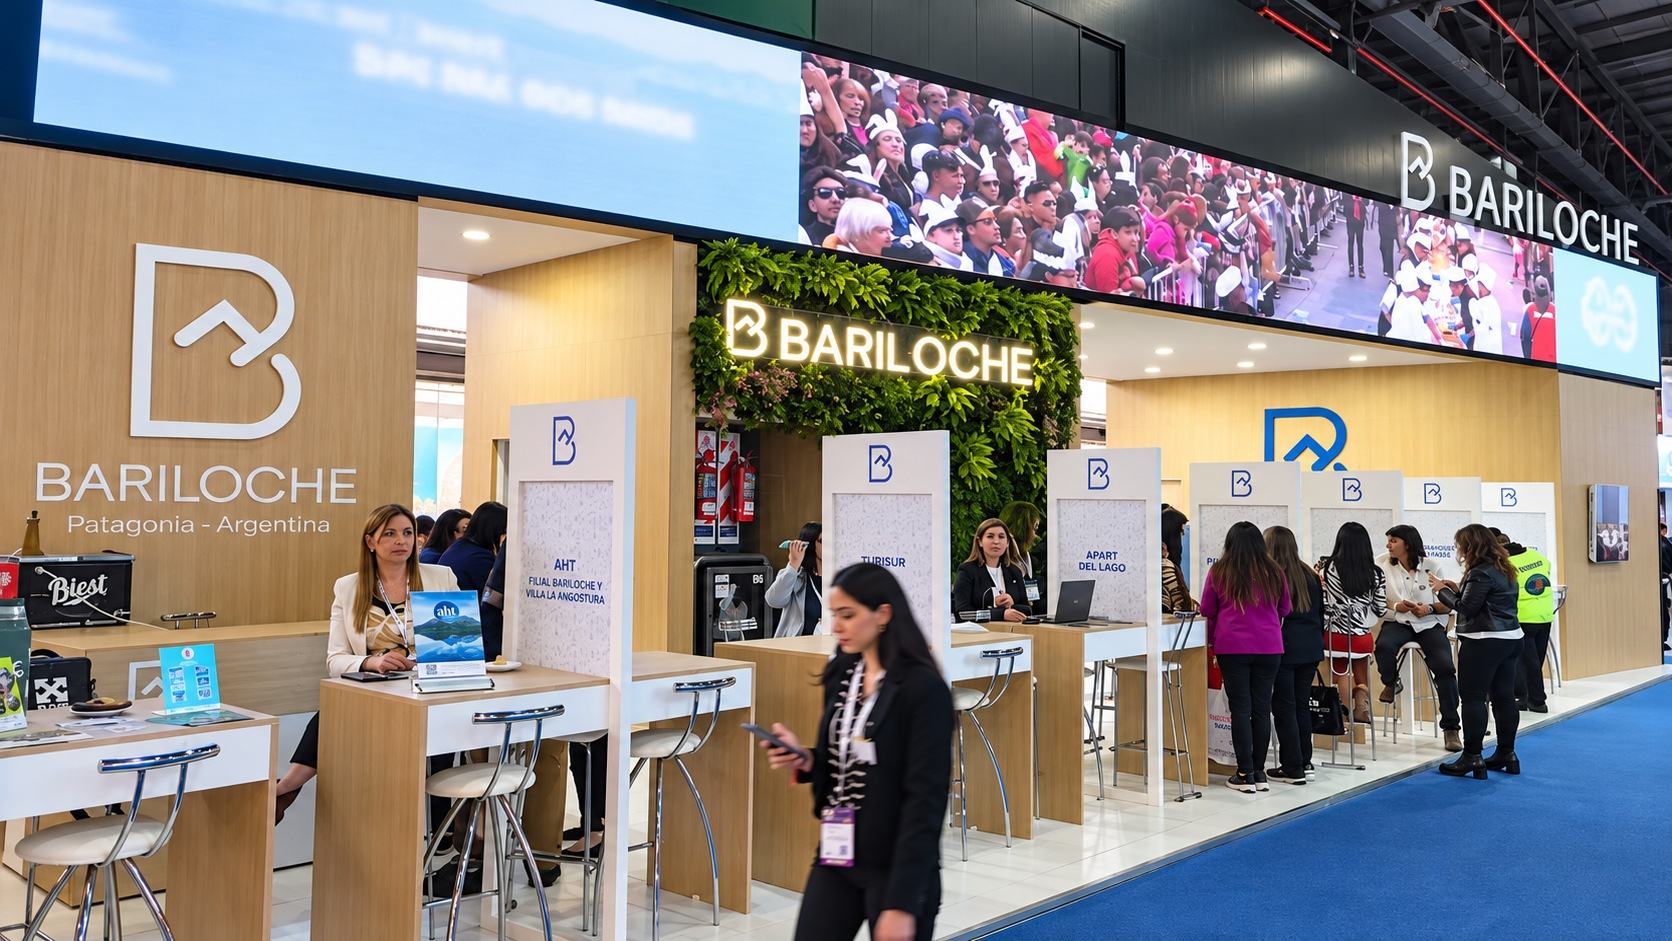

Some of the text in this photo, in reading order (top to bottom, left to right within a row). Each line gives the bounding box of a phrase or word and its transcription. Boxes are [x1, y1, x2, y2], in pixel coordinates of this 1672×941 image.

[1449, 165, 1640, 266] BARILOCHE
[780, 318, 1034, 386] BARILOCHE
[36, 462, 357, 504] BARILOCHE
[68, 515, 194, 537] Patagonia
[216, 515, 330, 537] Argentina
[861, 556, 906, 568] TURISUR
[1086, 550, 1118, 560] APART
[554, 559, 576, 571] AHT
[1078, 562, 1127, 573] DEL LAGO
[48, 573, 109, 607] Biest
[528, 577, 603, 591] FILIAL BARILOCHE Y
[526, 589, 605, 604] VILLA LA ANGOSTURA
[436, 605, 456, 617] aht
